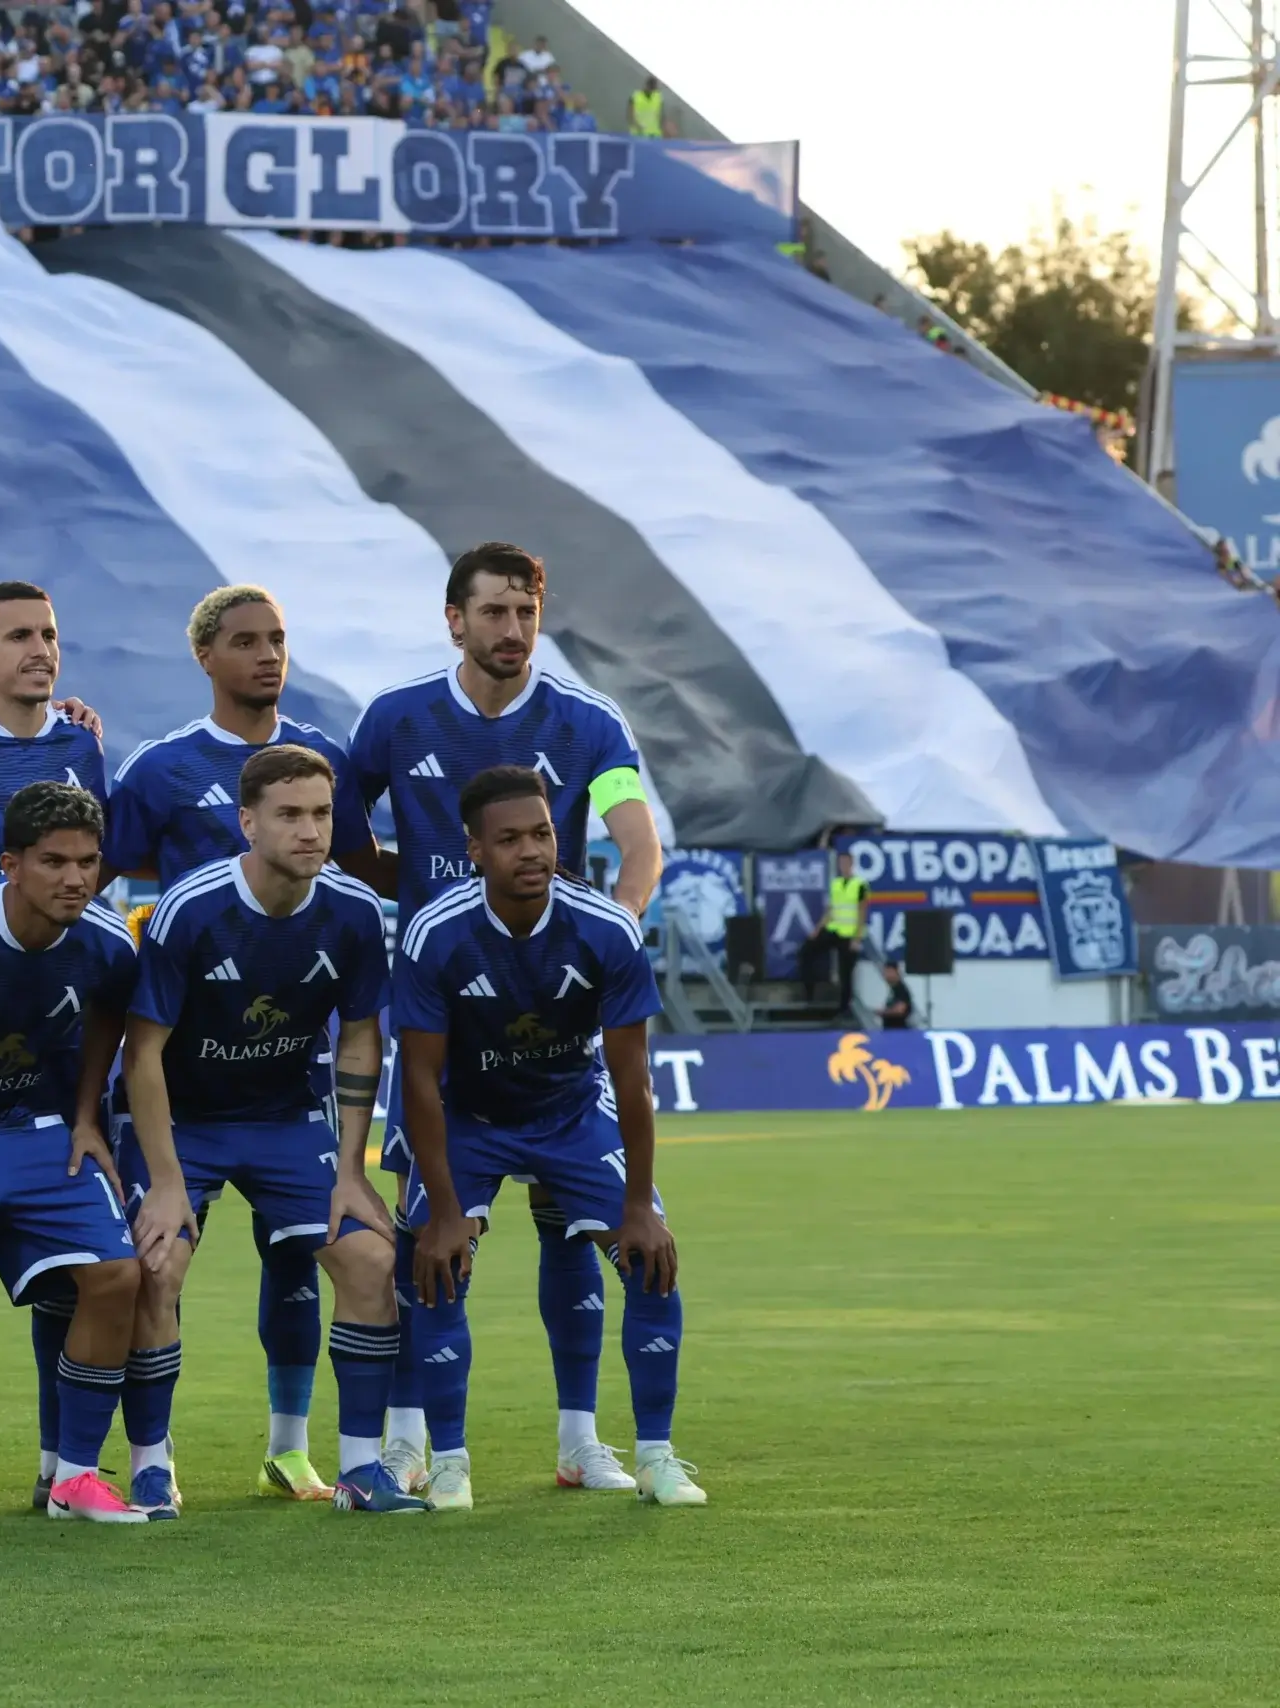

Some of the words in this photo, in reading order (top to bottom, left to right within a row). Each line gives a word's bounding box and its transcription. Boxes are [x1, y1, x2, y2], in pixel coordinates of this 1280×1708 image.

[223, 121, 635, 235] GLORY
[849, 839, 1037, 882] ОТБОРА
[931, 886, 966, 908] НА
[199, 1037, 274, 1061] PALMS
[274, 1034, 314, 1057] BET
[480, 1048, 543, 1071] PAMS
[924, 1030, 1179, 1109] PALMS
[1184, 1027, 1280, 1105] BE
